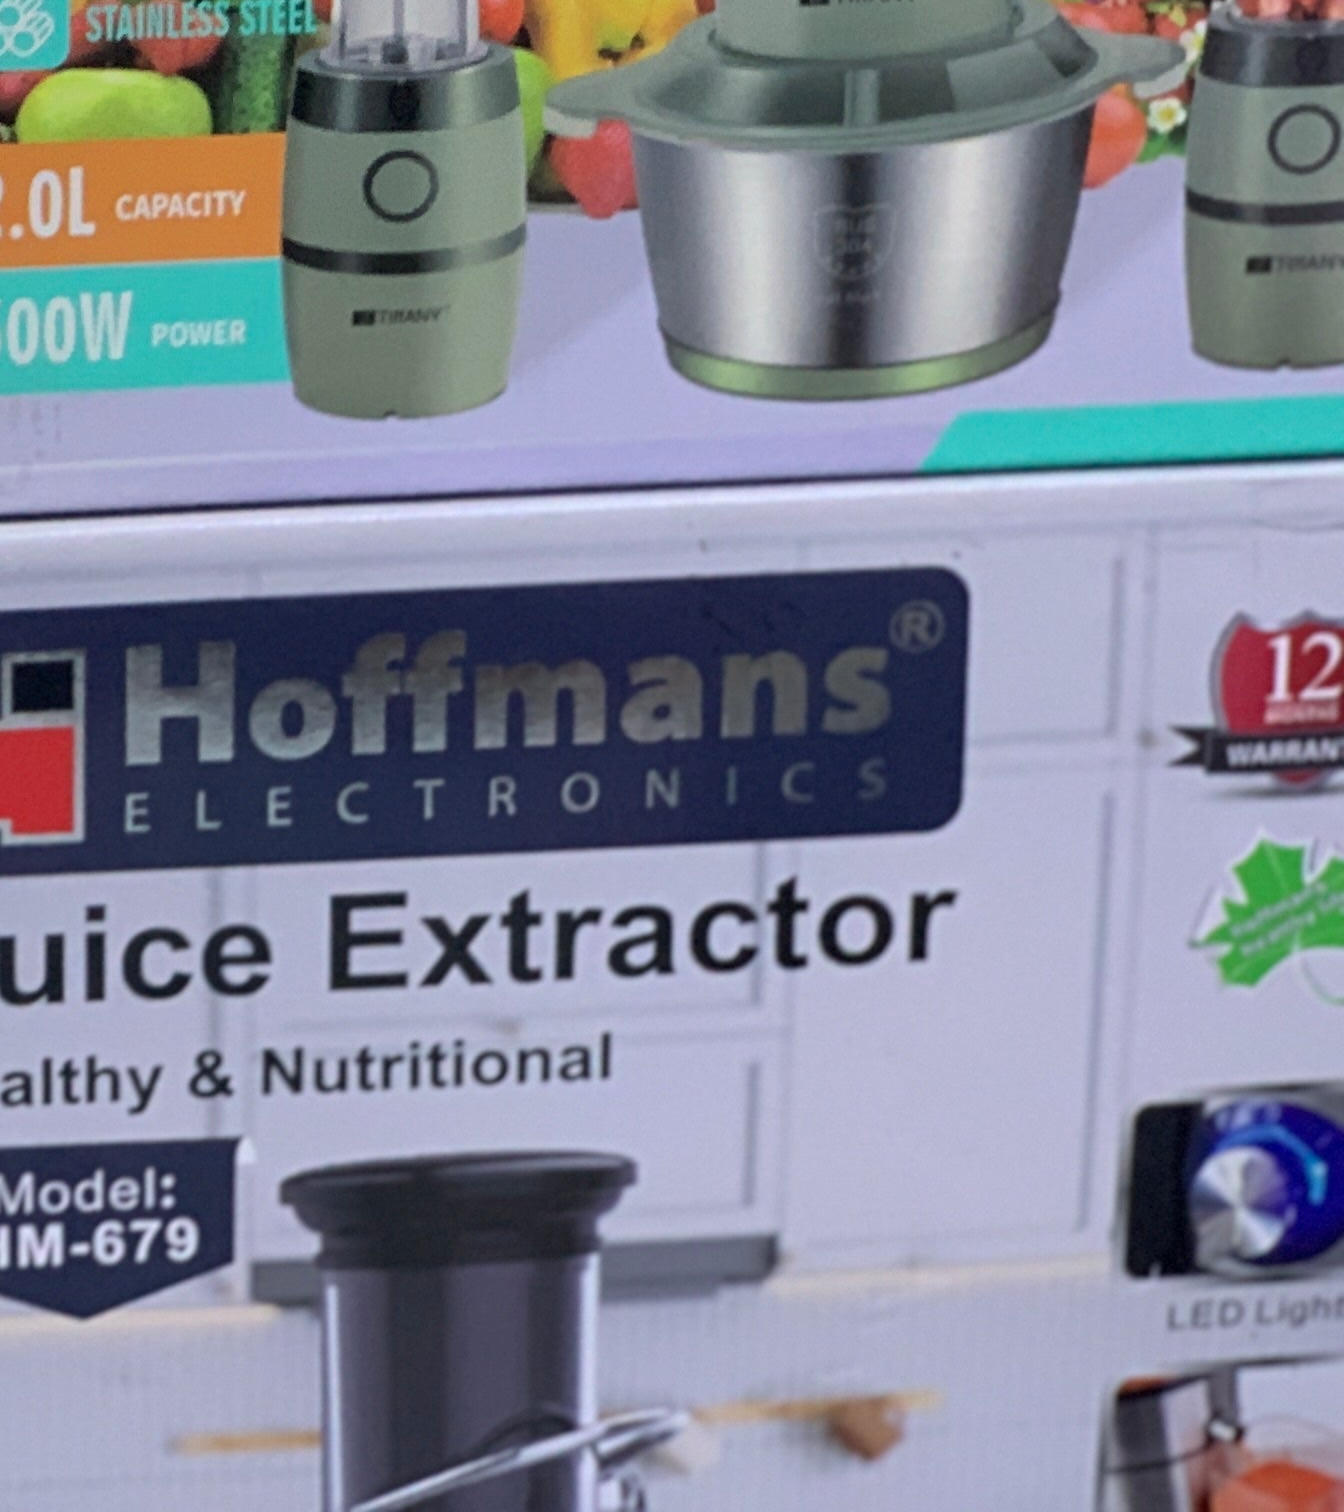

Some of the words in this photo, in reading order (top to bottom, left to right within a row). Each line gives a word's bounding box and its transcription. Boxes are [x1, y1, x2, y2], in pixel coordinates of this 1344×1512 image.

[86, 1, 230, 42] STAINLESS
[115, 189, 246, 221] CAPACITY
[151, 319, 246, 347] POWER
[125, 630, 892, 766] Hoffmans
[1266, 631, 1344, 703] 12
[125, 758, 887, 833] ELECTRONICS
[328, 875, 957, 992] Extractor
[188, 1049, 233, 1098] &
[261, 1033, 612, 1096] Nutritional
[1166, 1297, 1246, 1332] LED
